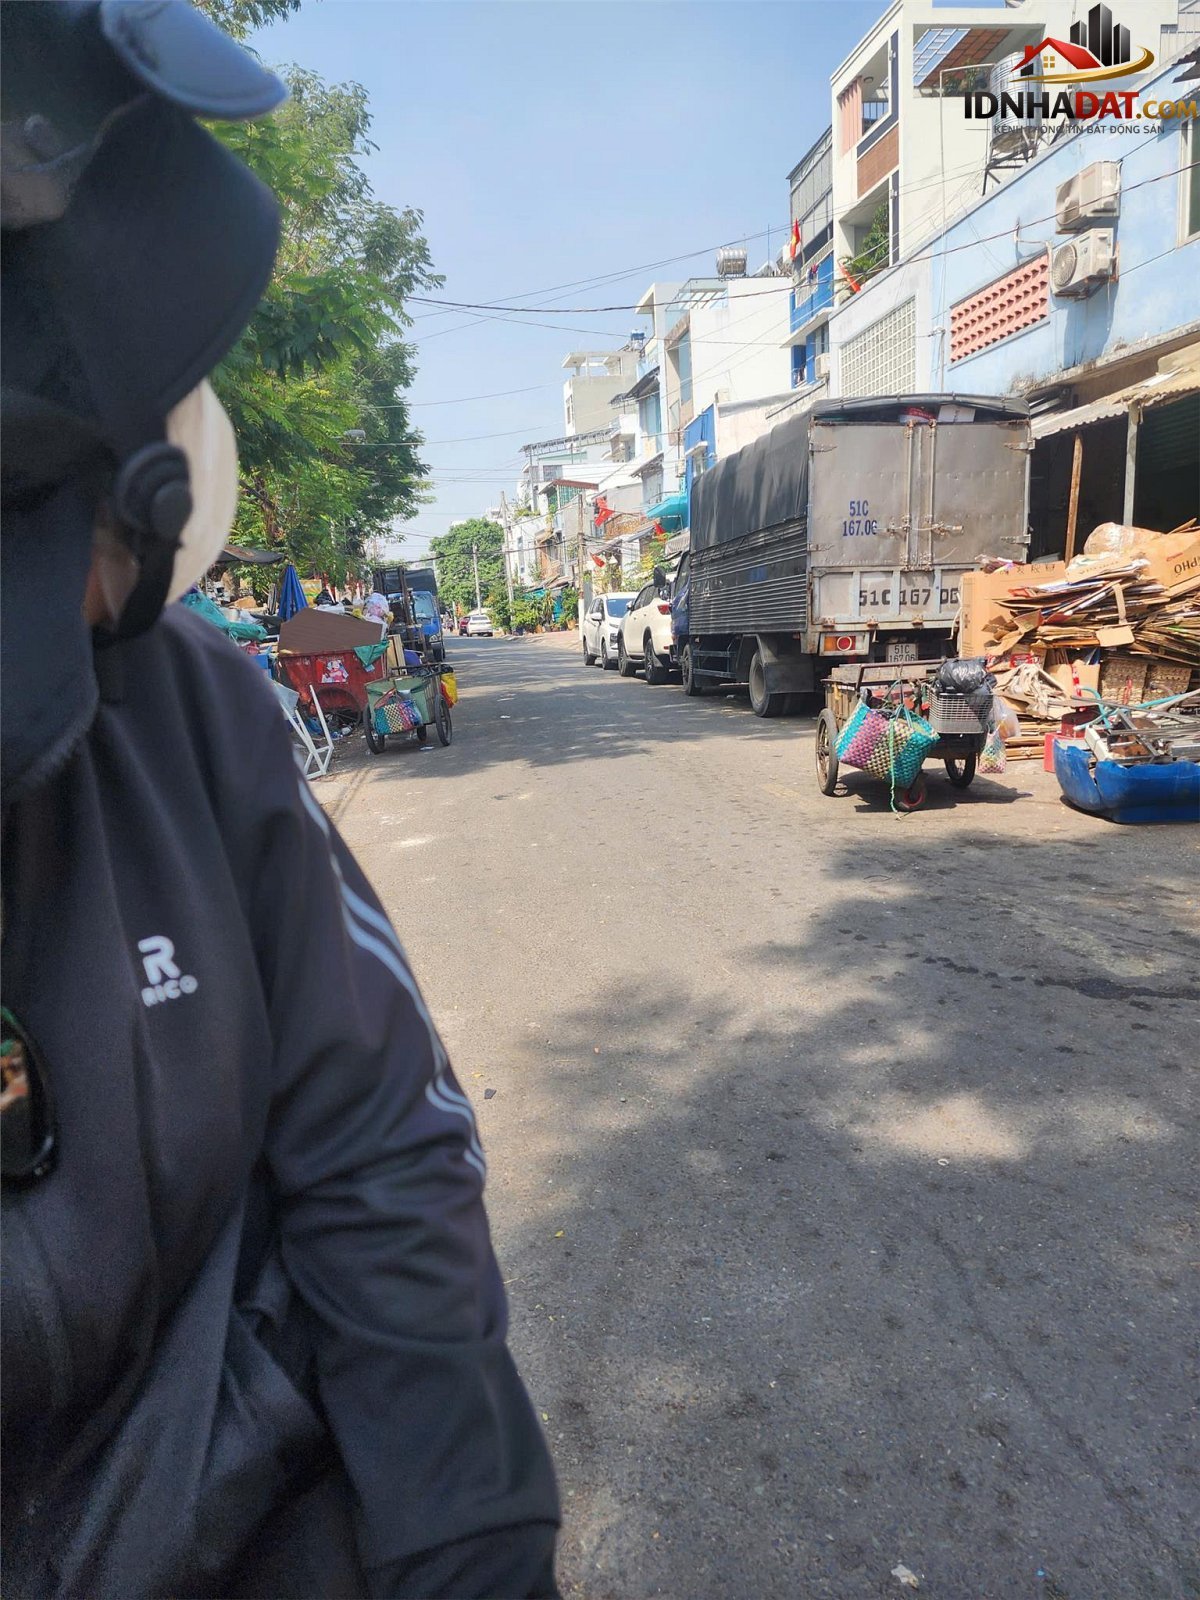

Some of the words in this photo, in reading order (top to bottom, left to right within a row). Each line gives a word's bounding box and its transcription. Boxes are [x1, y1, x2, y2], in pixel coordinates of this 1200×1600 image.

[849, 499, 869, 516] 51C
[842, 519, 877, 537] 167.06
[859, 589, 891, 606] 51C
[894, 644, 910, 655] 51C
[138, 935, 180, 985] R
